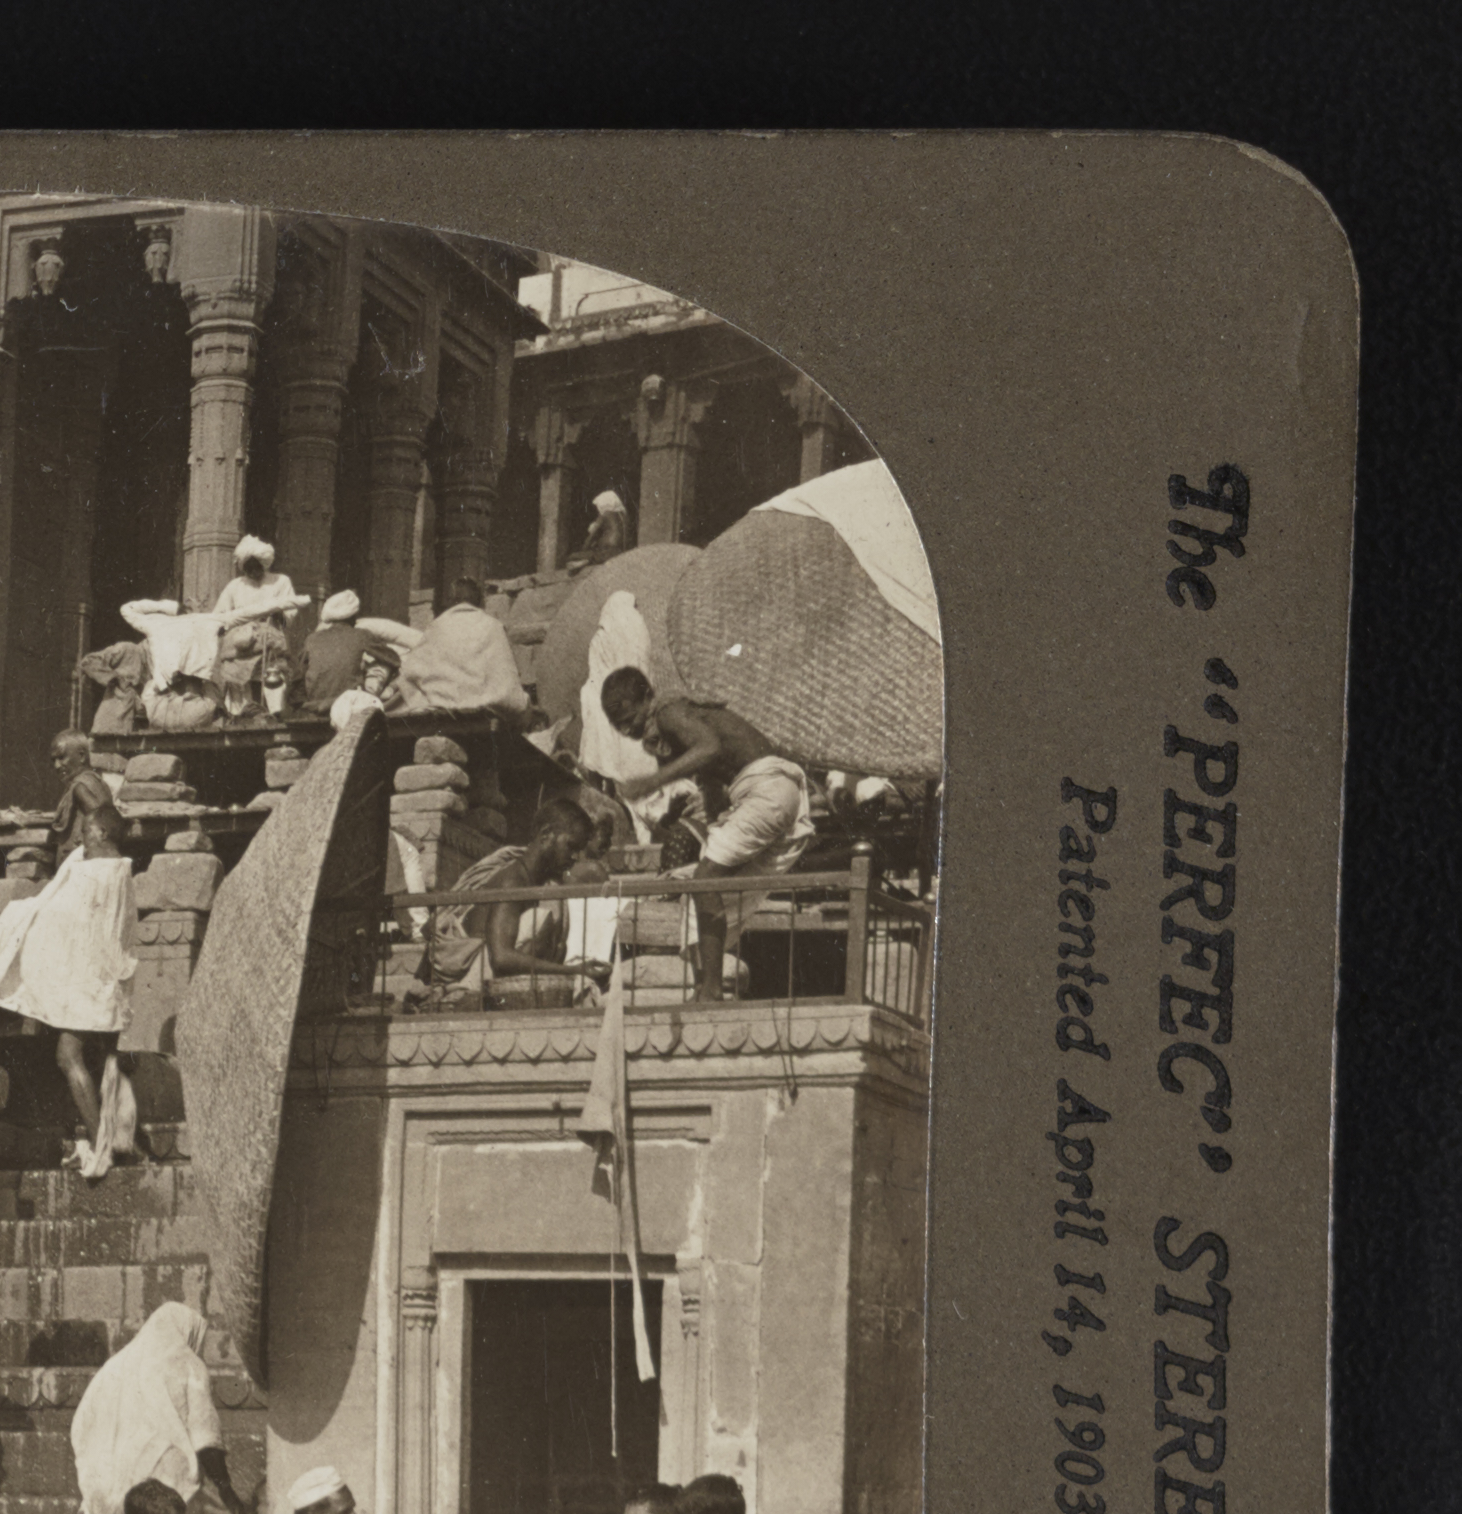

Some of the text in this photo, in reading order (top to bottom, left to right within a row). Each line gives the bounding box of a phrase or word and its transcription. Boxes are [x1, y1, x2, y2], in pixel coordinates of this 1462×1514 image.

[1166, 462, 1252, 611] The
[1055, 776, 1118, 1062] Patented
[1045, 1078, 1112, 1247] April
[1041, 1263, 1107, 1357] 14,
